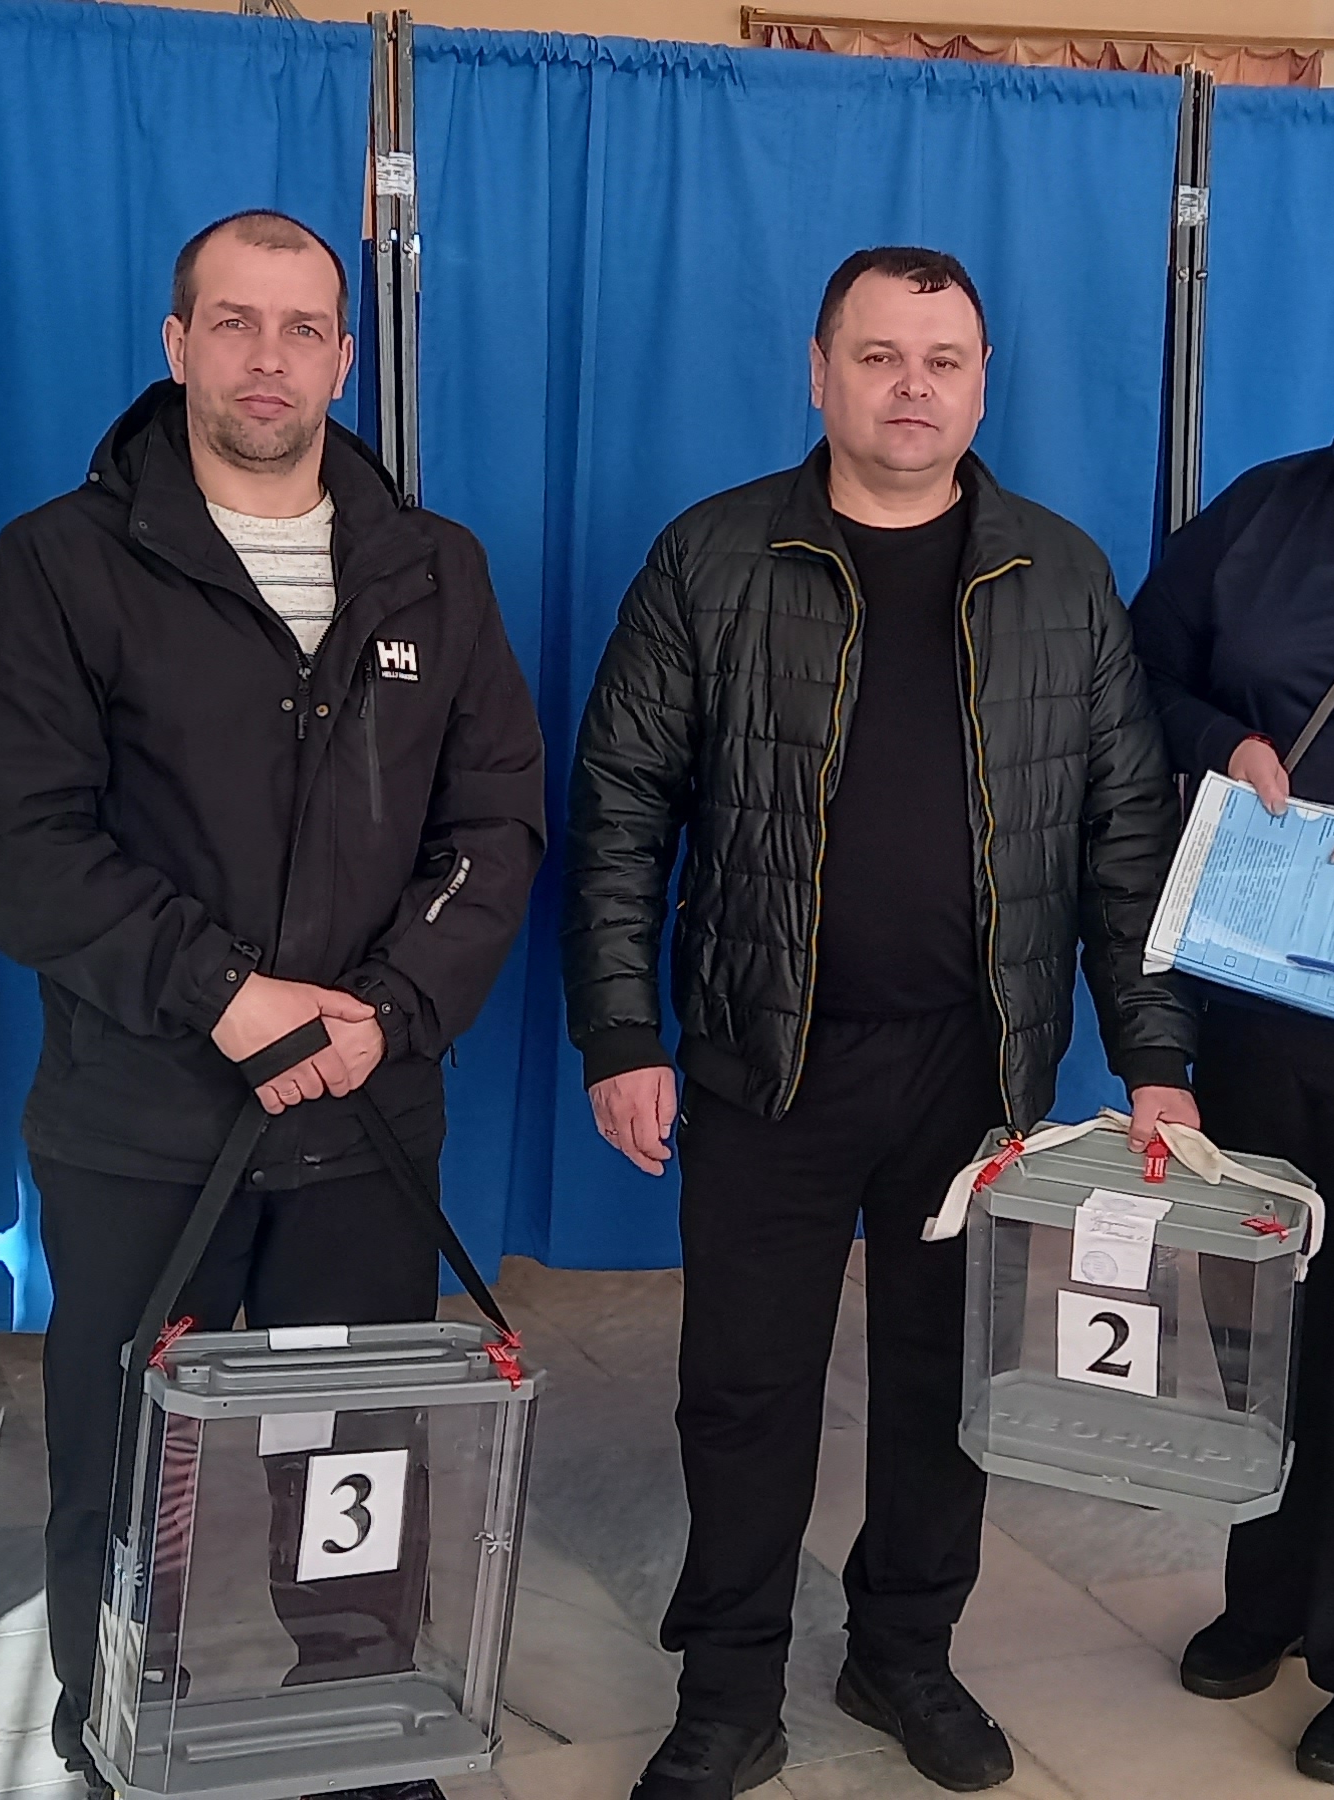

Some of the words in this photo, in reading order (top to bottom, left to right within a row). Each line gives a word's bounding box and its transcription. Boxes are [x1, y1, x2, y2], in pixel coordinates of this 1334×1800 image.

[376, 640, 418, 672] HH
[1085, 1311, 1133, 1378] 2
[321, 1473, 373, 1555] 3
